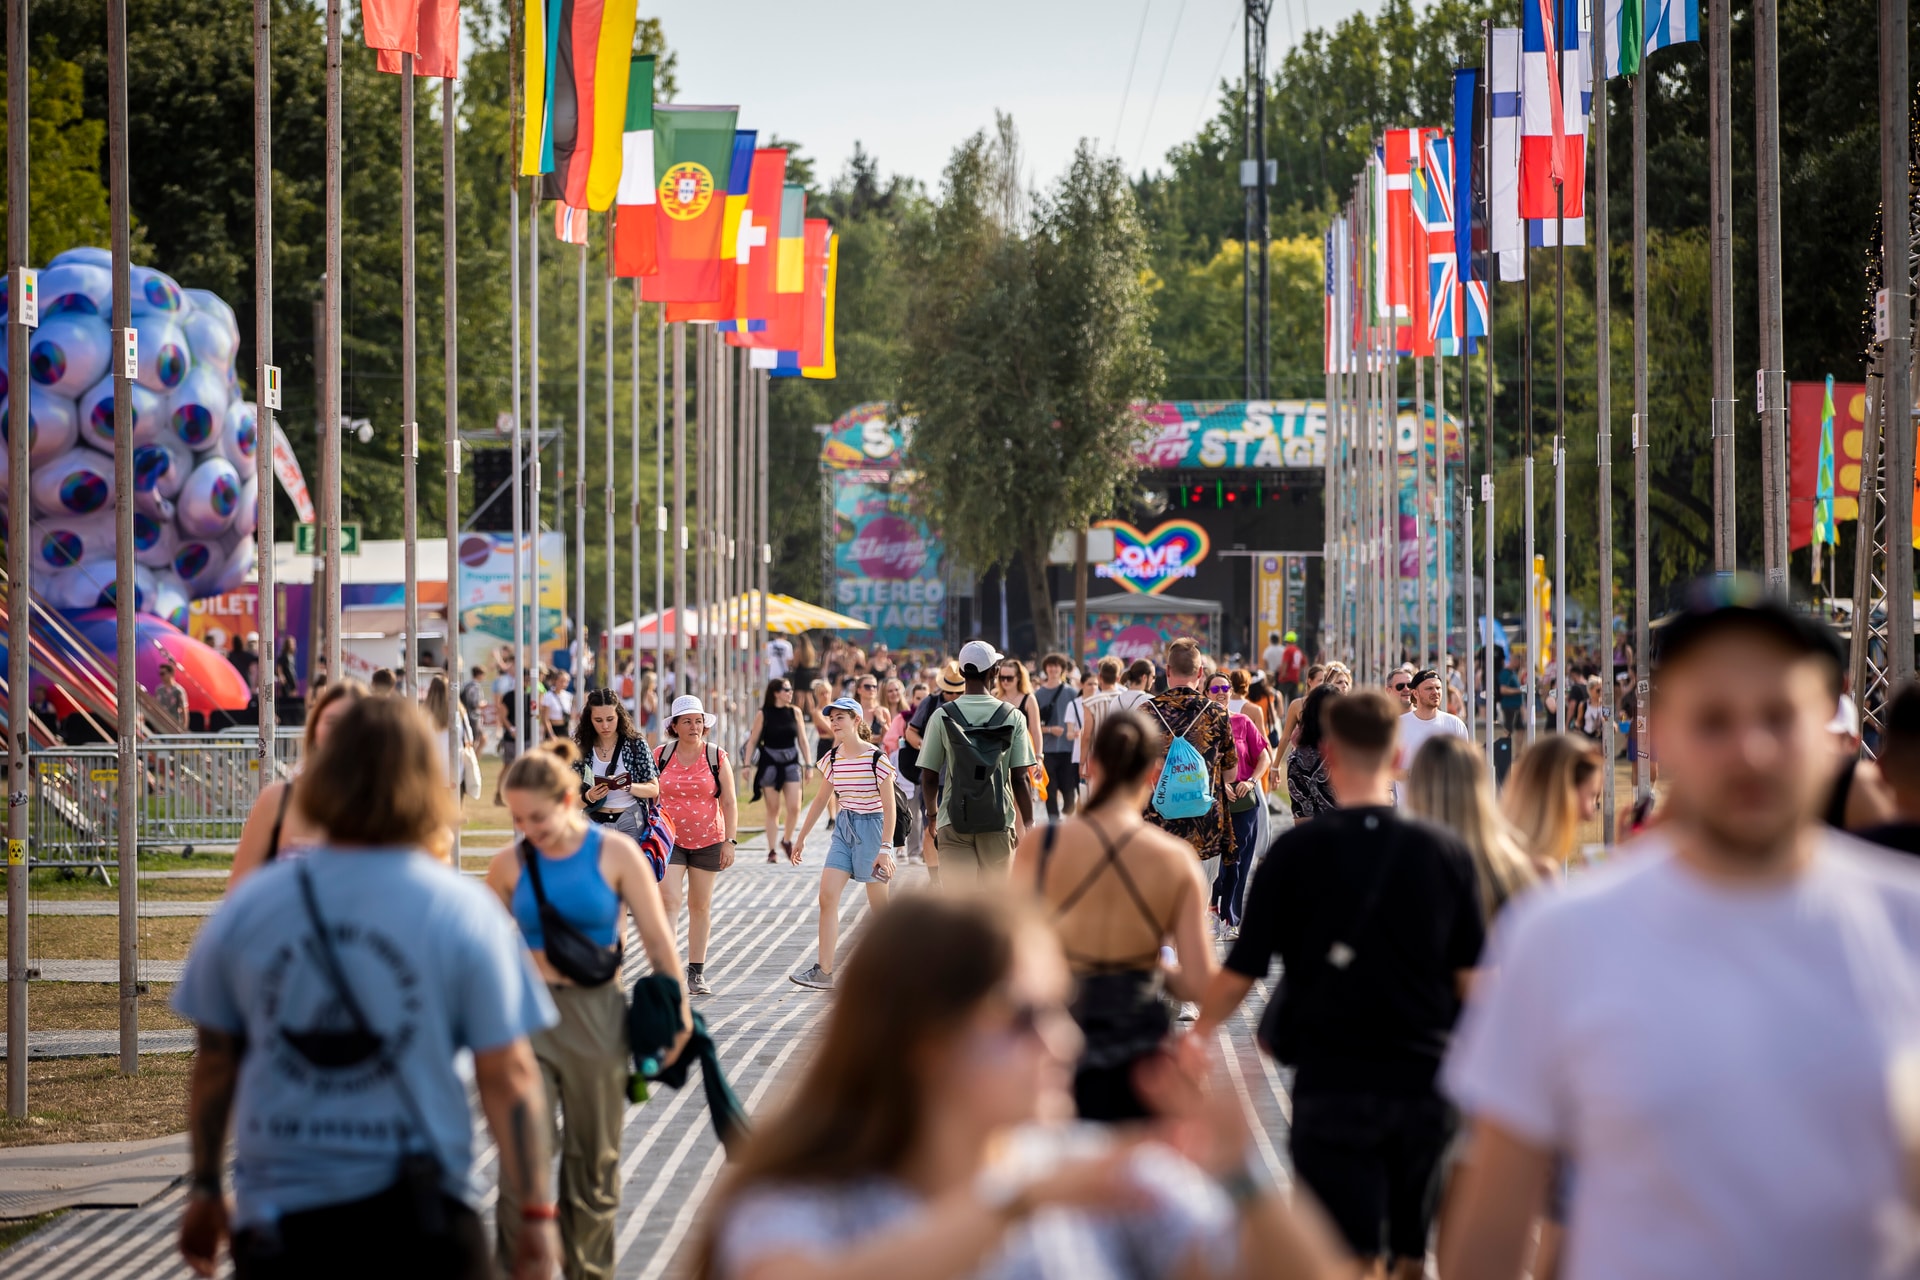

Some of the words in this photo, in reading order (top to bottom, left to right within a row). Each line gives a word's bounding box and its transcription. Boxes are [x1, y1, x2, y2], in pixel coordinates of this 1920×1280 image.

[1114, 544, 1183, 566] OVE
[1095, 563, 1197, 578] REVOLUTION
[837, 577, 945, 604] STEREO
[190, 593, 258, 615] OILET
[847, 605, 939, 629] STAGE
[1156, 774, 1169, 805] CHOWN
